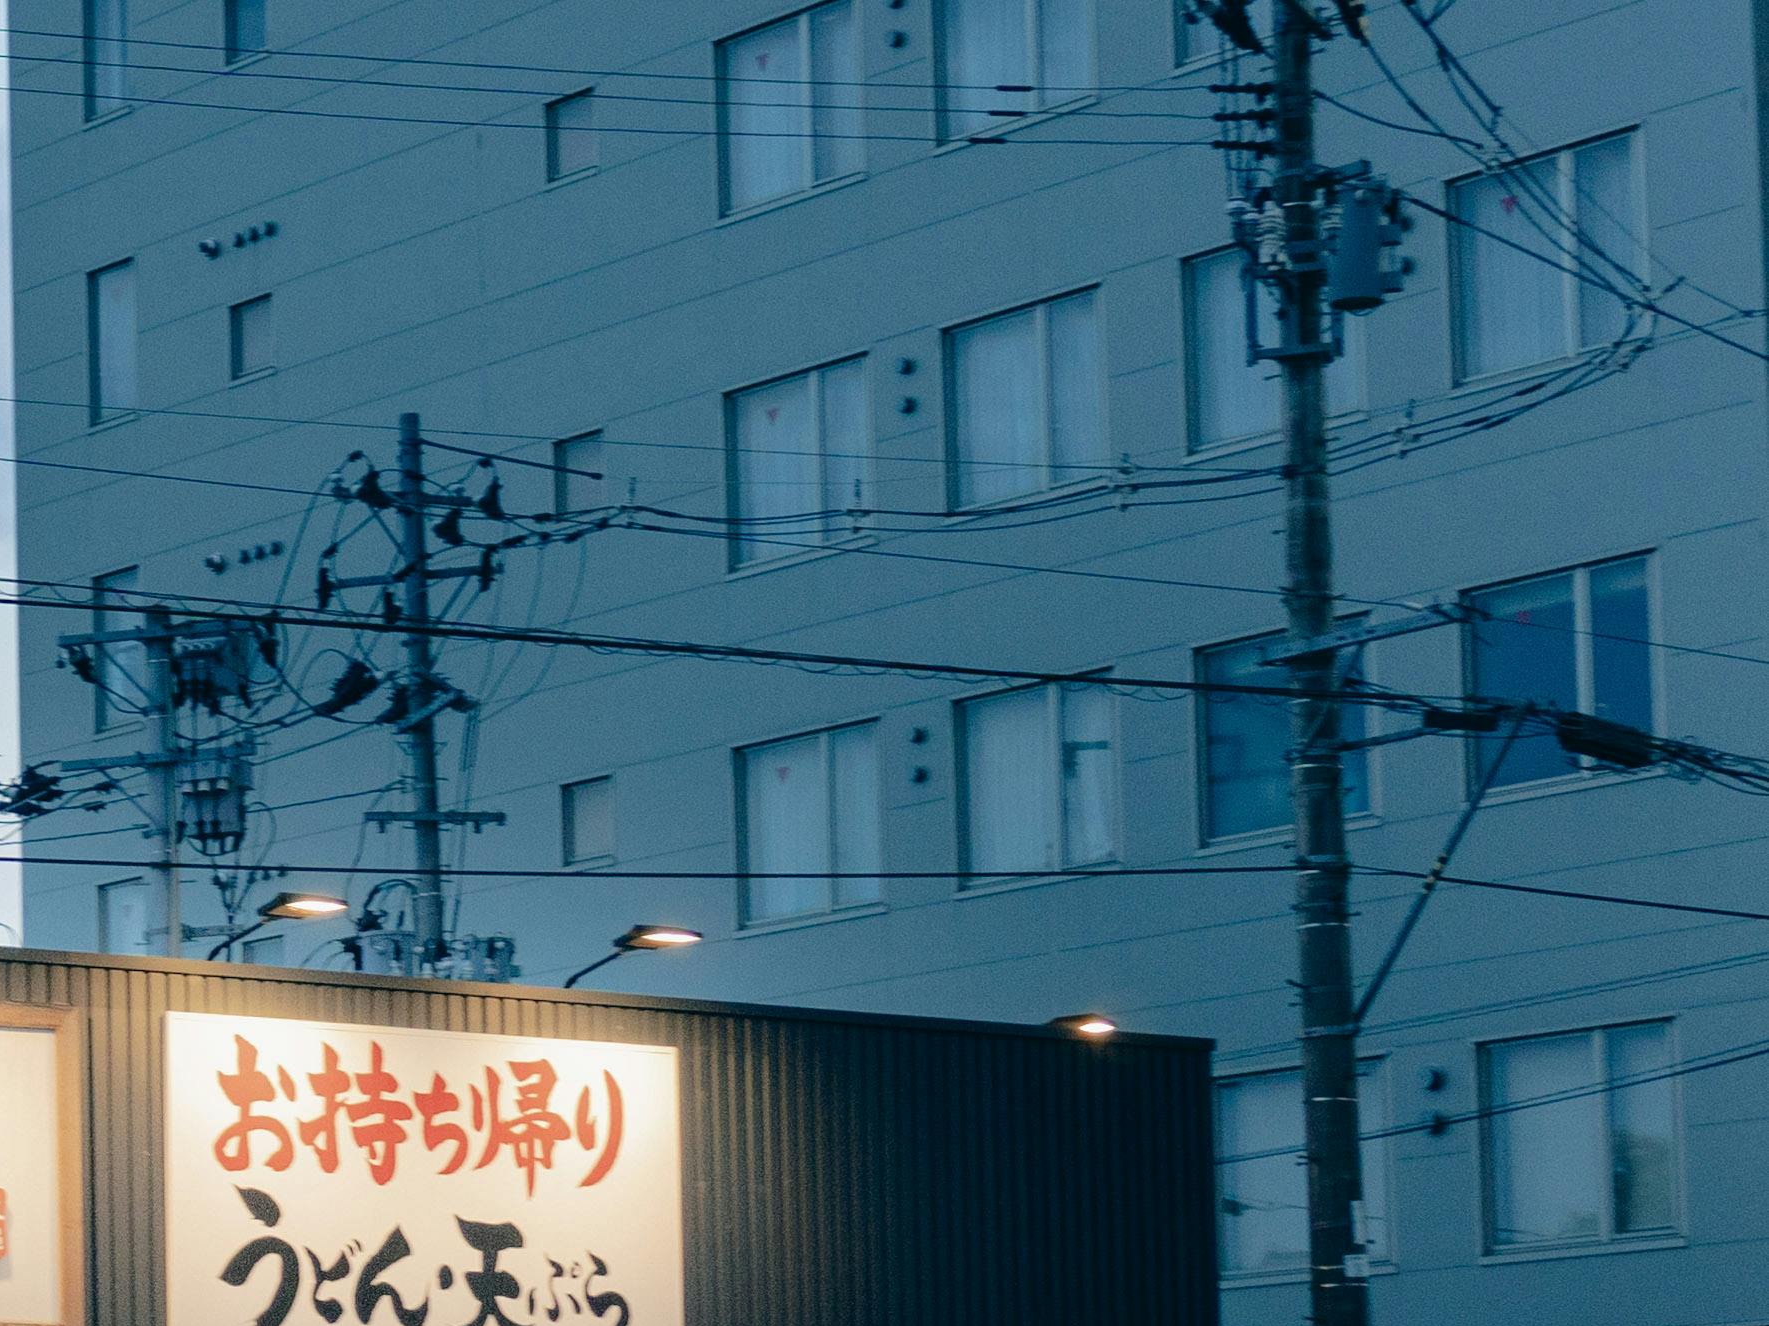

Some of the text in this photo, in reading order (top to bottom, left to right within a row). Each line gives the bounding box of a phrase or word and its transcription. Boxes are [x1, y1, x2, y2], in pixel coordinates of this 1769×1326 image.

[211, 1033, 625, 1200] お持ち帰り
